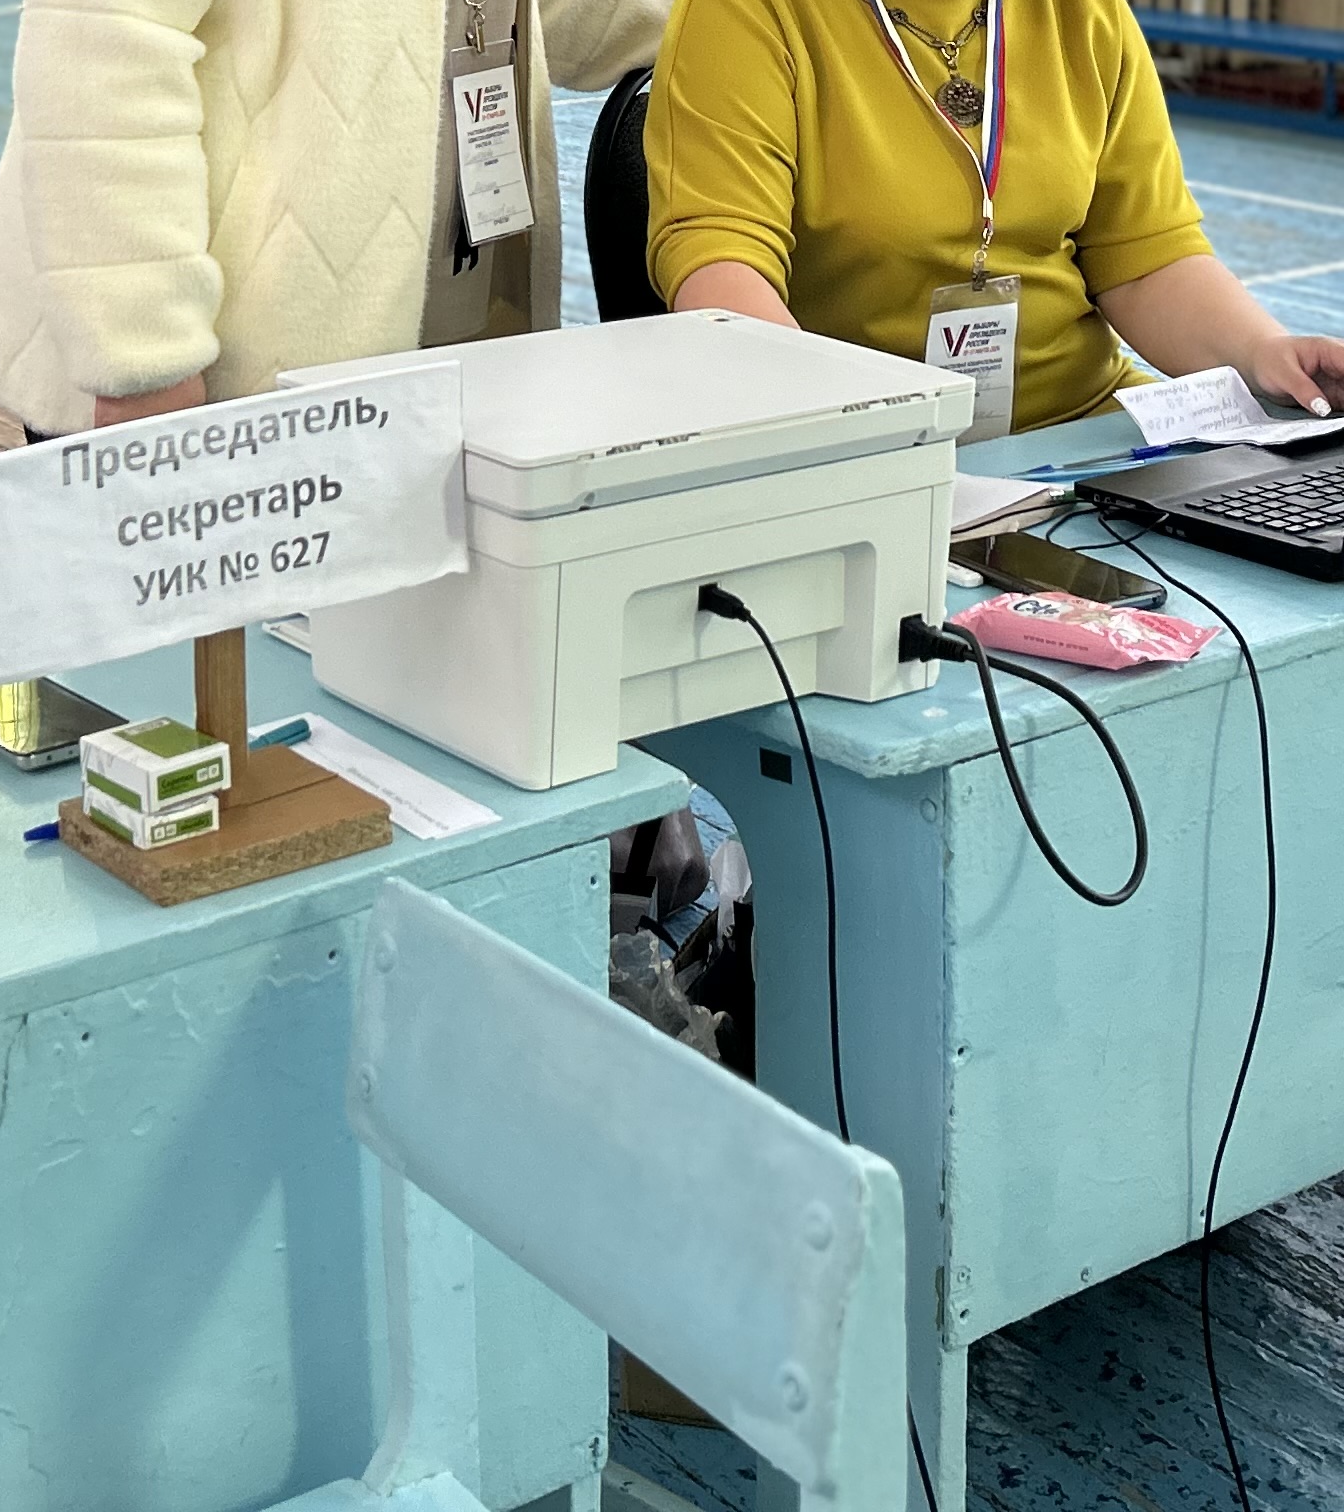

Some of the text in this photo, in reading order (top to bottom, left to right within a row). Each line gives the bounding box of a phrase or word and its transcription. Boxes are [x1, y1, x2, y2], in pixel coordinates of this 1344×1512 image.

[61, 395, 390, 489] Председатель,
[117, 473, 344, 547] секретарь
[133, 530, 331, 606] УИК № 627
